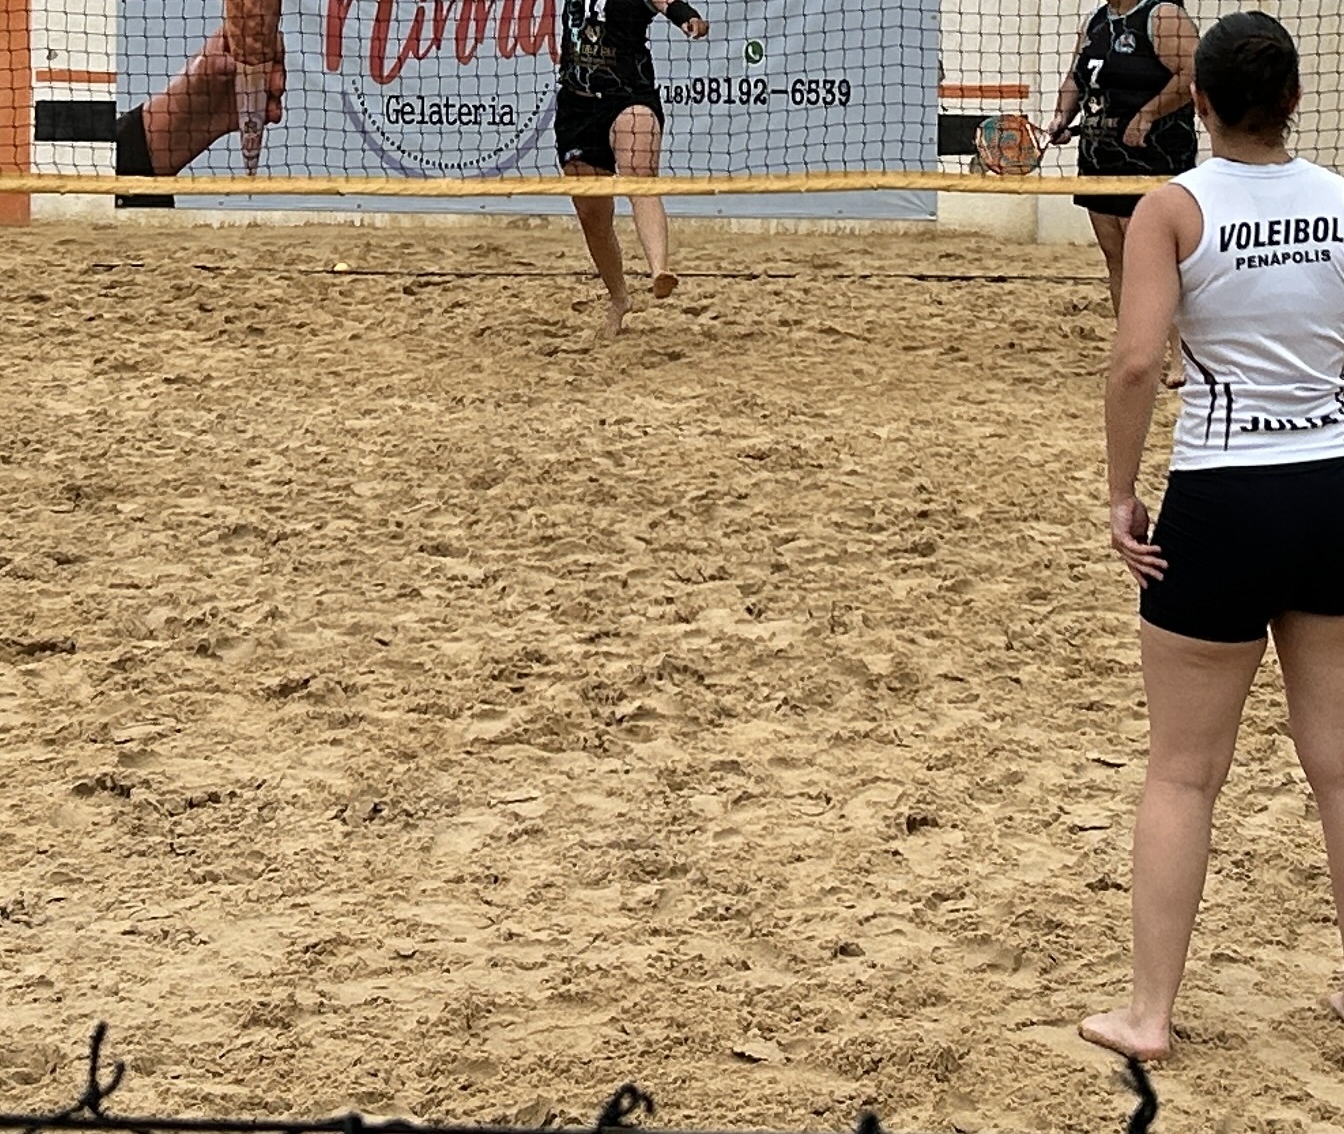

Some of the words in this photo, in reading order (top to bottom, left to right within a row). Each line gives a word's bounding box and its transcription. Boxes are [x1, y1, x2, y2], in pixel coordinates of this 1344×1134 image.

[1087, 59, 1104, 89] 7
[385, 95, 515, 126] Gelateria
[1219, 216, 1344, 253] VOLEIBOL
